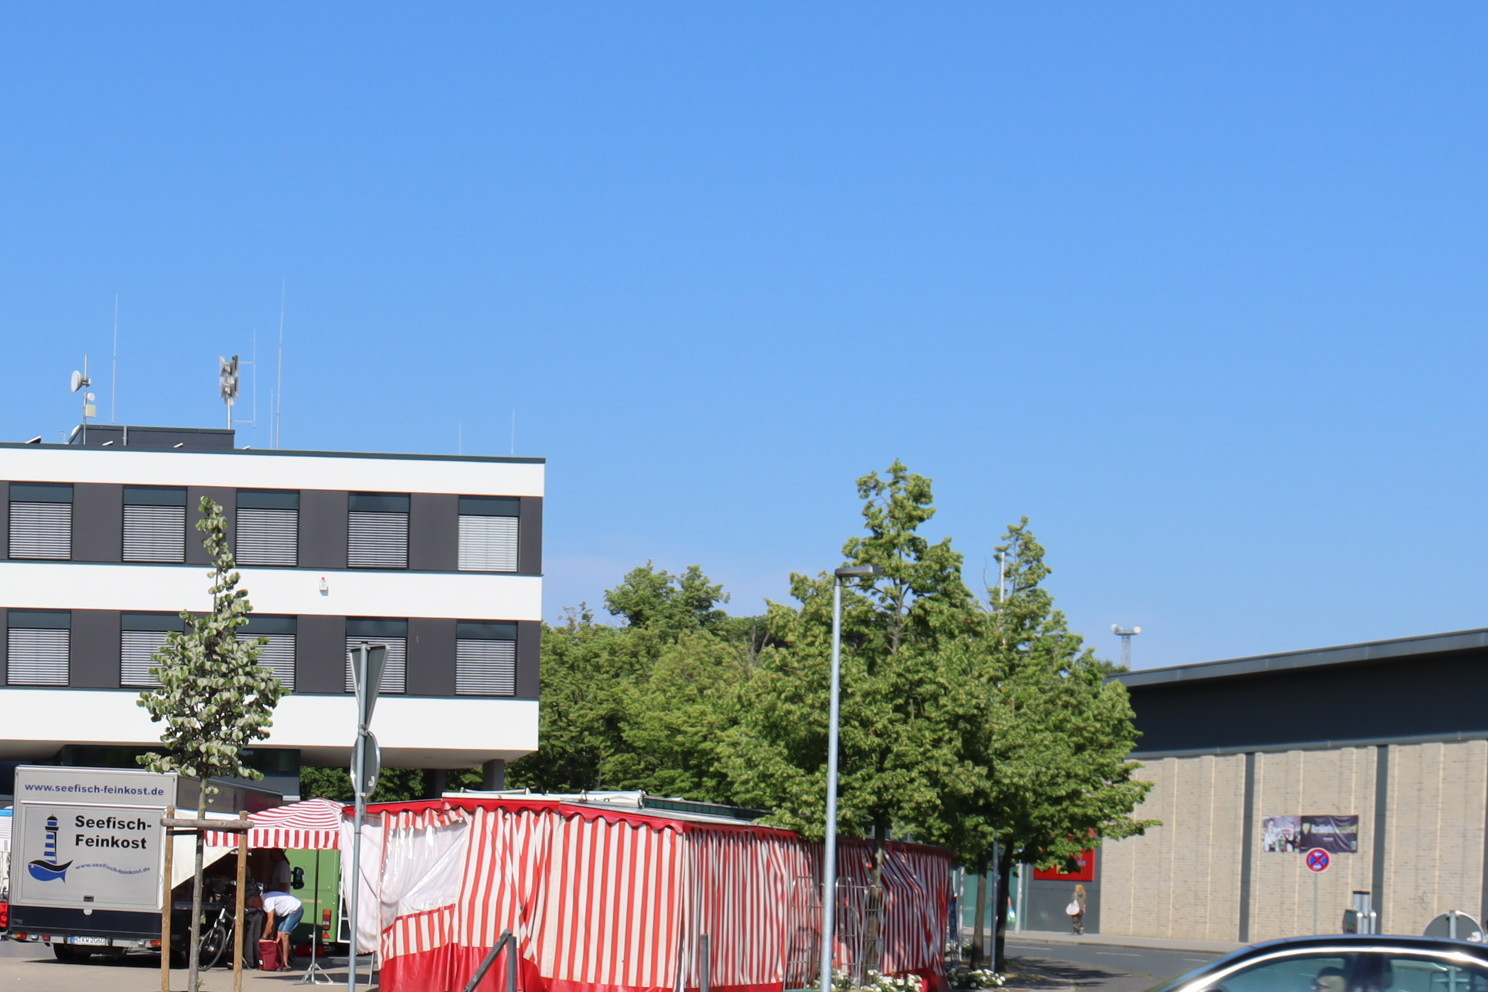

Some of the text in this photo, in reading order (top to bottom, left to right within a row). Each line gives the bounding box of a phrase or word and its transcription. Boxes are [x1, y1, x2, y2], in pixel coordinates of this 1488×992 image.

[24, 783, 165, 796] www.seefisch-feinkost.de
[75, 815, 152, 831] Seefisch-
[75, 834, 147, 850] Feinkost
